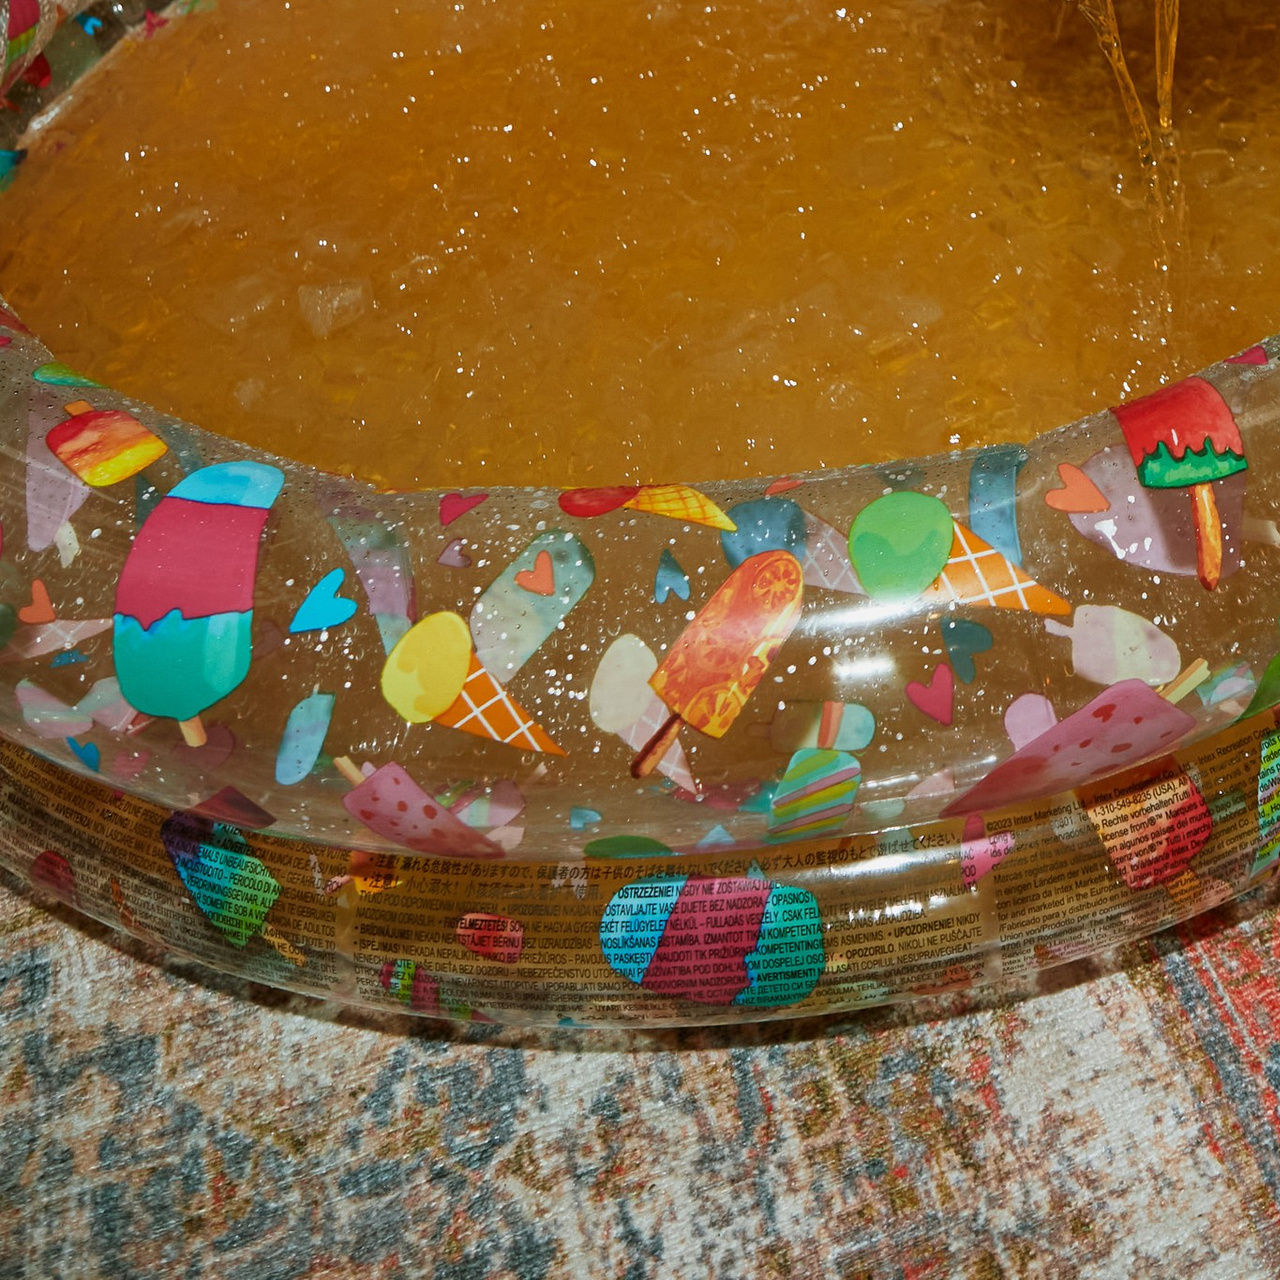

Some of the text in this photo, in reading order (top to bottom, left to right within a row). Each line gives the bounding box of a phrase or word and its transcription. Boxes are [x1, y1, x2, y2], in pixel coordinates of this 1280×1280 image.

[1093, 782, 1177, 818] 1-310-549-8235 (USA).
[1101, 812, 1129, 829] Rechte
[1130, 790, 1191, 818] vorbehalten/Tutti
[1165, 802, 1198, 821] Marques
[1107, 844, 1117, 854] en
[1119, 835, 1149, 852] algunos
[228, 871, 264, 892] PERICOLO
[617, 884, 674, 899] OSTRZEŻENIE!
[675, 883, 700, 897] NIGDY
[702, 882, 714, 895] NIE
[1042, 888, 1053, 899] da
[1054, 883, 1073, 896] Intex
[1075, 870, 1114, 892] Marketing
[605, 902, 657, 917] OSTAVLJAJTE
[680, 899, 709, 914] DIJETE
[709, 897, 725, 912] BEZ
[725, 895, 764, 911] NADZORA
[1010, 907, 1026, 919] and
[1027, 897, 1065, 915] marketed
[1076, 888, 1089, 900] the
[1090, 878, 1129, 898] European
[1042, 911, 1060, 924] para
[1068, 896, 1109, 915] distribuido
[233, 901, 248, 915] SOB
[303, 920, 336, 938] ADULTOS
[620, 918, 668, 933] FELÜGYELET
[670, 916, 699, 931] NÉLKÜL
[705, 913, 744, 929] FULLADÁS
[782, 907, 804, 921] CSAK
[521, 937, 536, 949] BEZ
[602, 933, 656, 949] NOSLĪKŠANAS
[703, 930, 744, 945] IZMANTOT
[767, 920, 827, 939] KOMPETENTAS
[574, 952, 612, 965] PAVOJUS
[656, 949, 693, 963] NAUDOTI
[694, 948, 707, 961] TIK
[893, 920, 955, 938] UPOZORNENIE!
[956, 912, 981, 927] NIKDY
[1000, 931, 1024, 942] Union
[459, 962, 474, 975] BEZ
[517, 964, 591, 979] NEBEZPEČENSTVO
[693, 963, 711, 975] POD
[762, 956, 804, 971] DOSPELEJ
[845, 943, 897, 960] OPOZORILO.
[898, 938, 924, 953] NIKOLI
[926, 936, 939, 948] NE
[940, 926, 983, 944] PUŠČAJTE
[597, 981, 621, 991] SAMO
[756, 967, 816, 982] AVERTISMENT!
[896, 943, 973, 965] NESUPRAVEGHEAT
